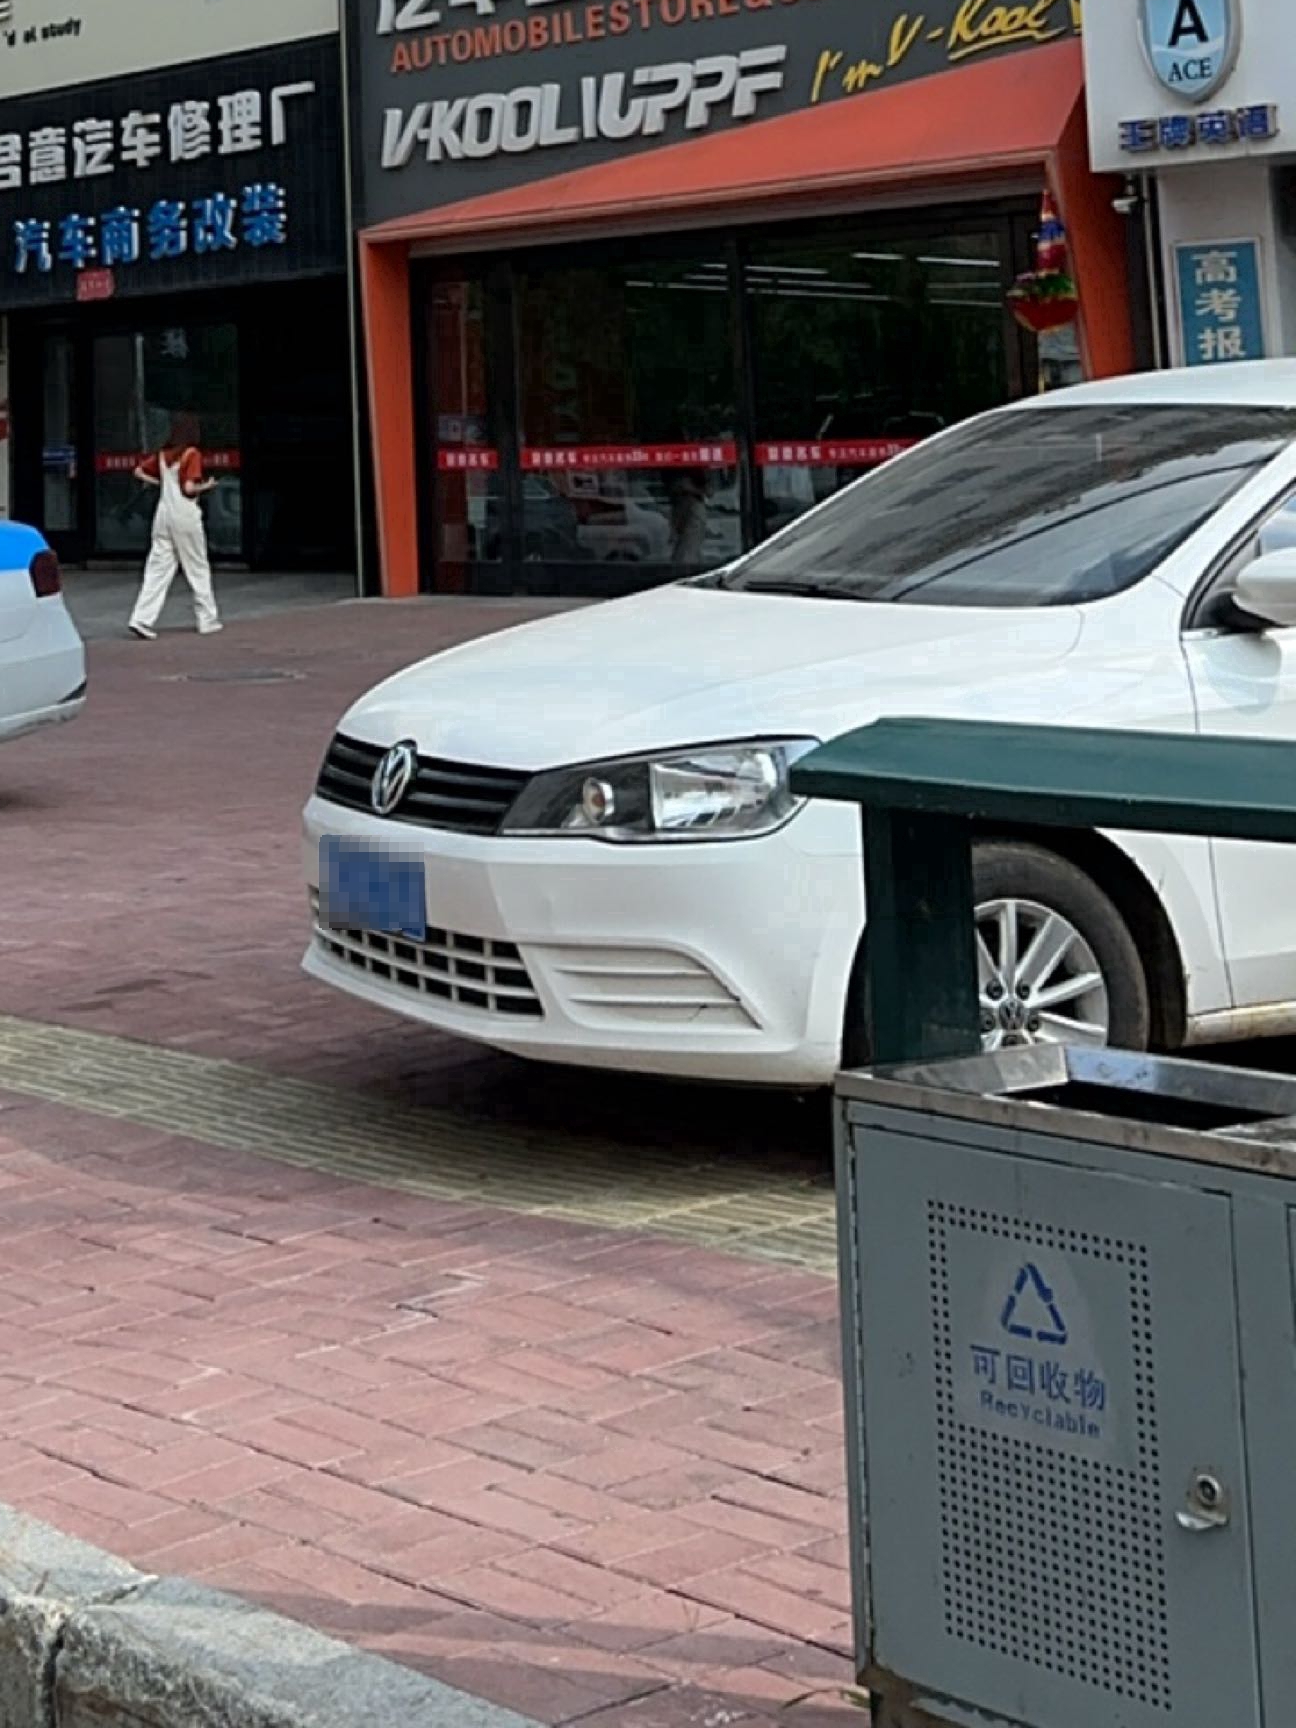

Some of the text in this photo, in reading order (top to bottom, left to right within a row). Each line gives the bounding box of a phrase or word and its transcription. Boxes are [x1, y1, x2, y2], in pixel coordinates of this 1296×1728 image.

[41, 16, 83, 40] study
[1169, 56, 1212, 82] ACE
[14, 182, 287, 272] 汽车商务改装
[970, 1344, 1106, 1411] 可回收物
